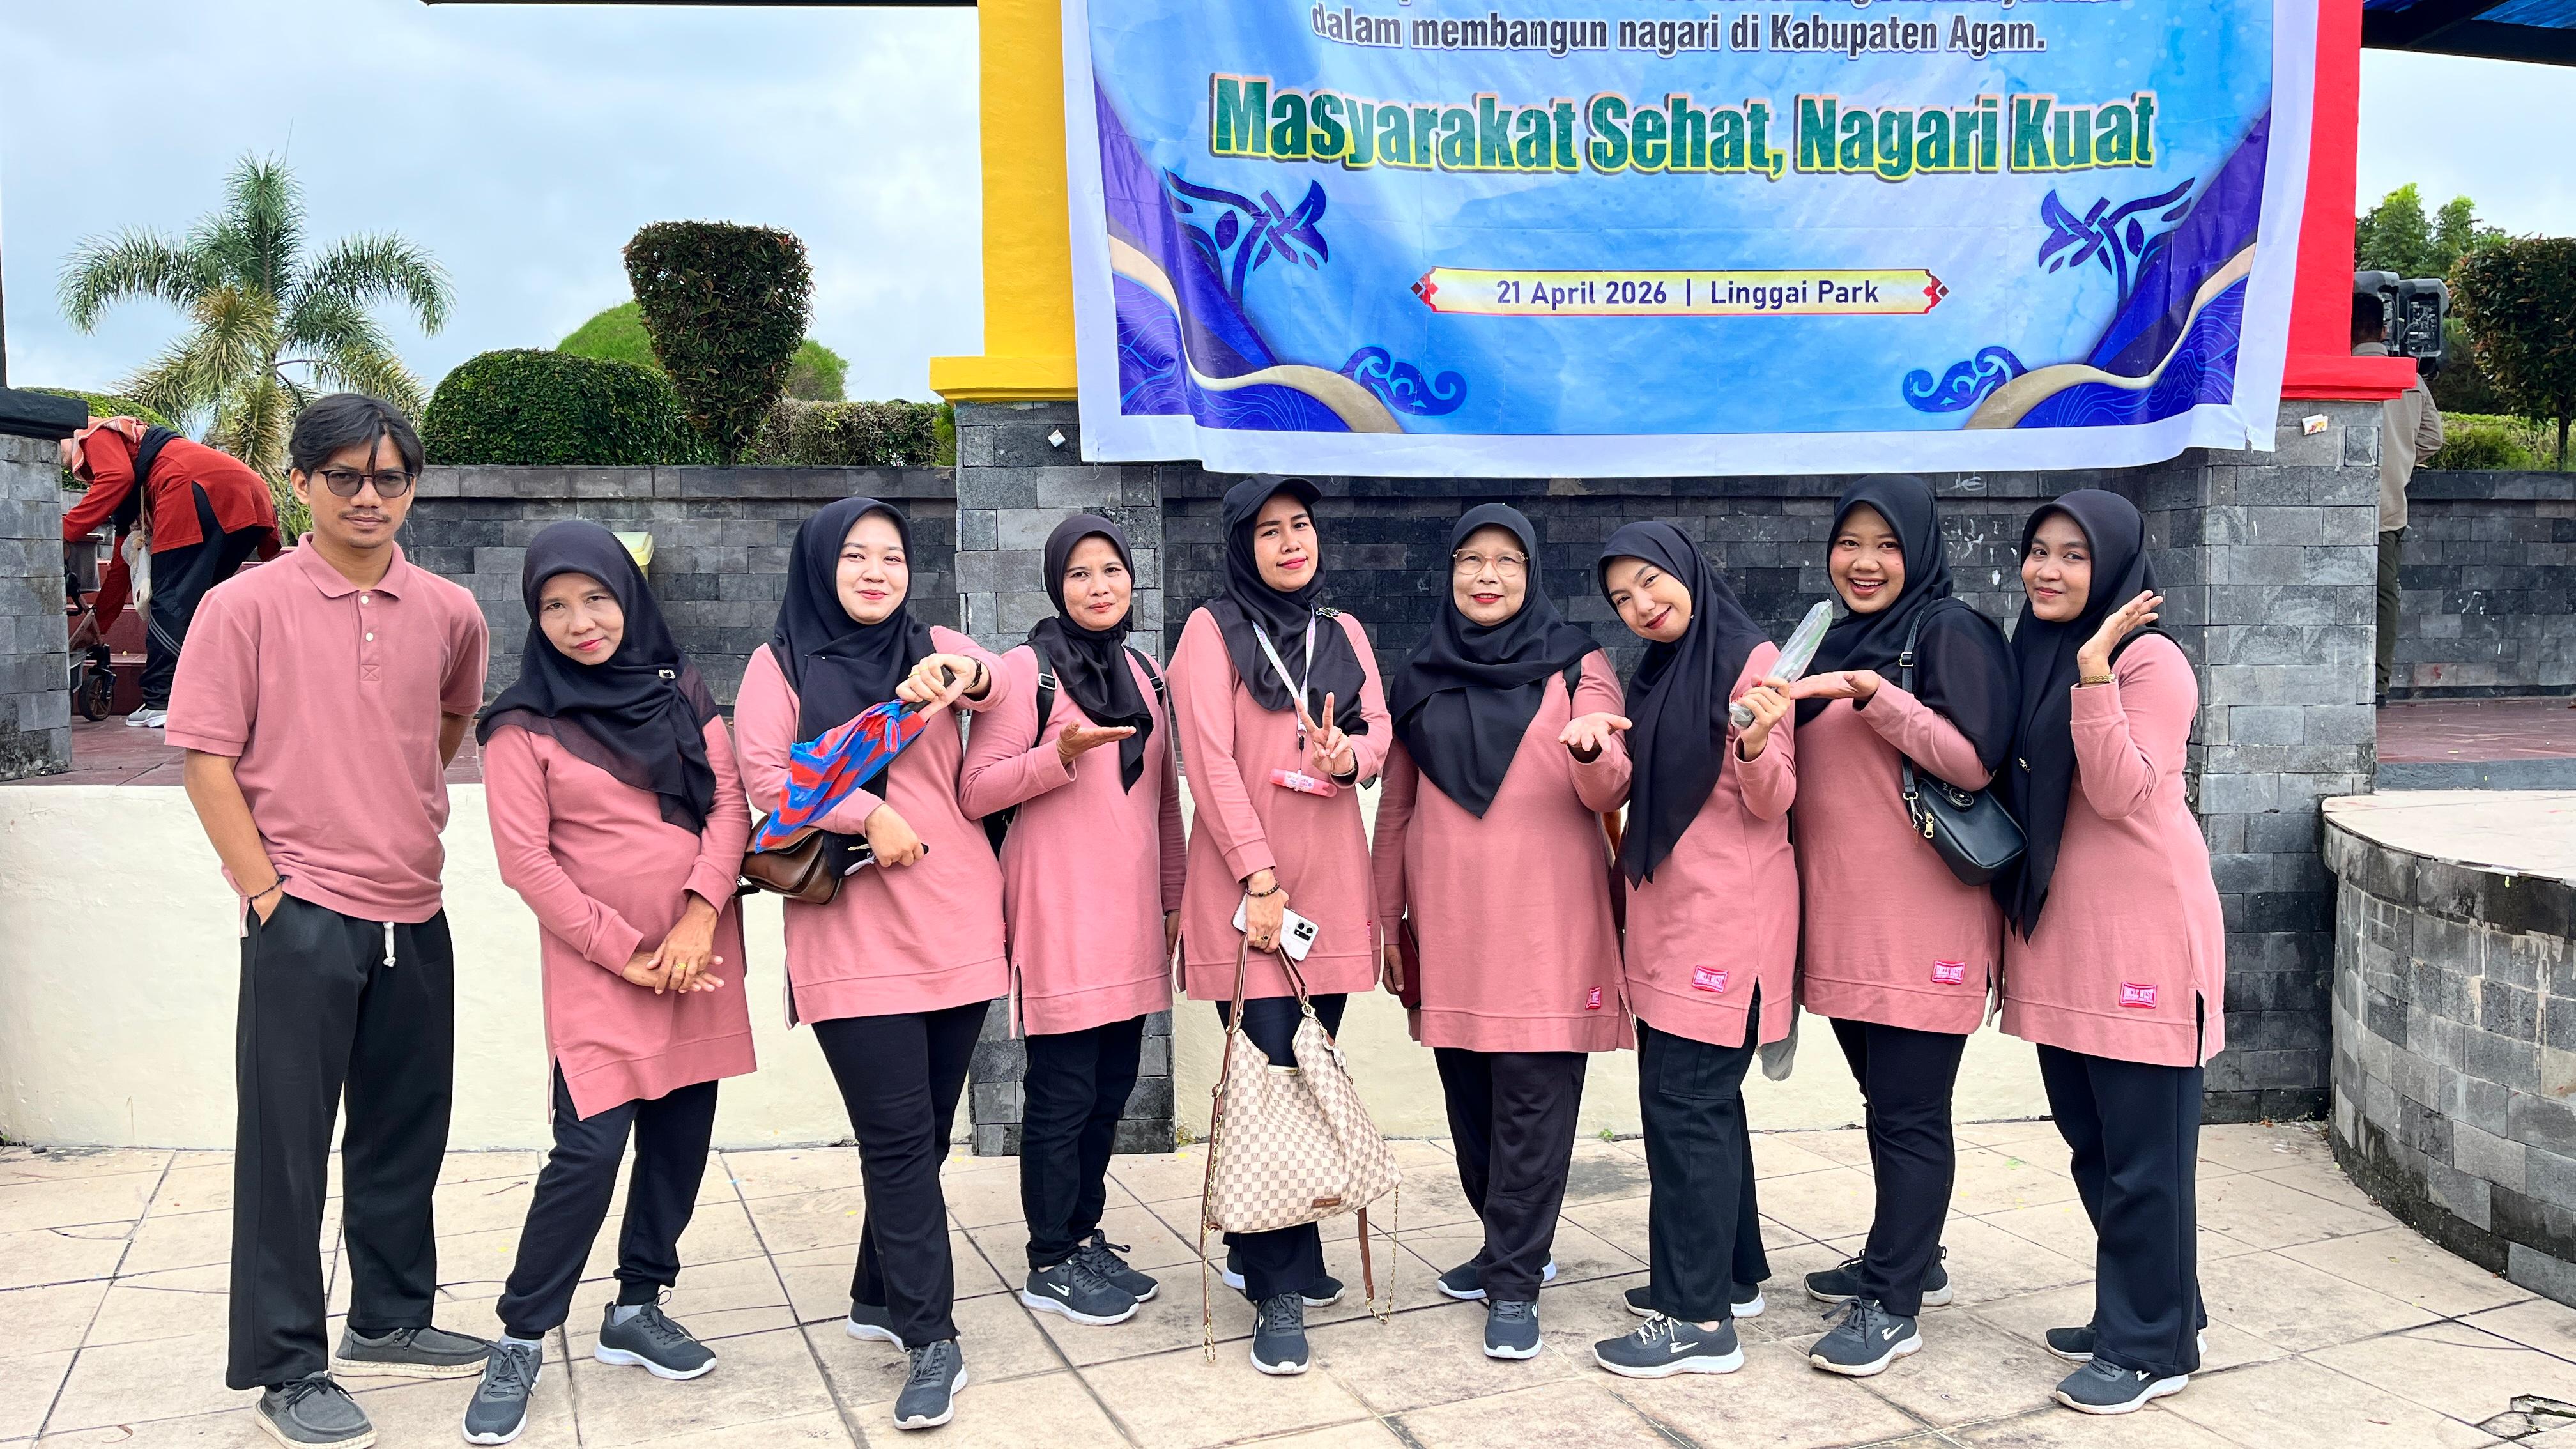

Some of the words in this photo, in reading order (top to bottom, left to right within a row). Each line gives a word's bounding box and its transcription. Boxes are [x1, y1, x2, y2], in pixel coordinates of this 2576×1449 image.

[1312, 3, 1401, 44] dalam
[1413, 13, 1606, 55] membangun
[1620, 14, 1719, 55] nagari
[1731, 14, 1759, 49] di
[1771, 14, 1937, 57] Kabupaten
[1949, 15, 2045, 56] Agam.
[1213, 77, 1578, 170] Masyarakat
[1590, 96, 1784, 176] Sehat,
[1799, 97, 1998, 178] Nagari
[2012, 96, 2155, 169] Kuat
[1496, 280, 1520, 304] 21
[1530, 281, 1596, 310] April
[1606, 281, 1667, 304] 2026
[1711, 280, 1807, 310] Linggai
[1818, 280, 1880, 304] Park
